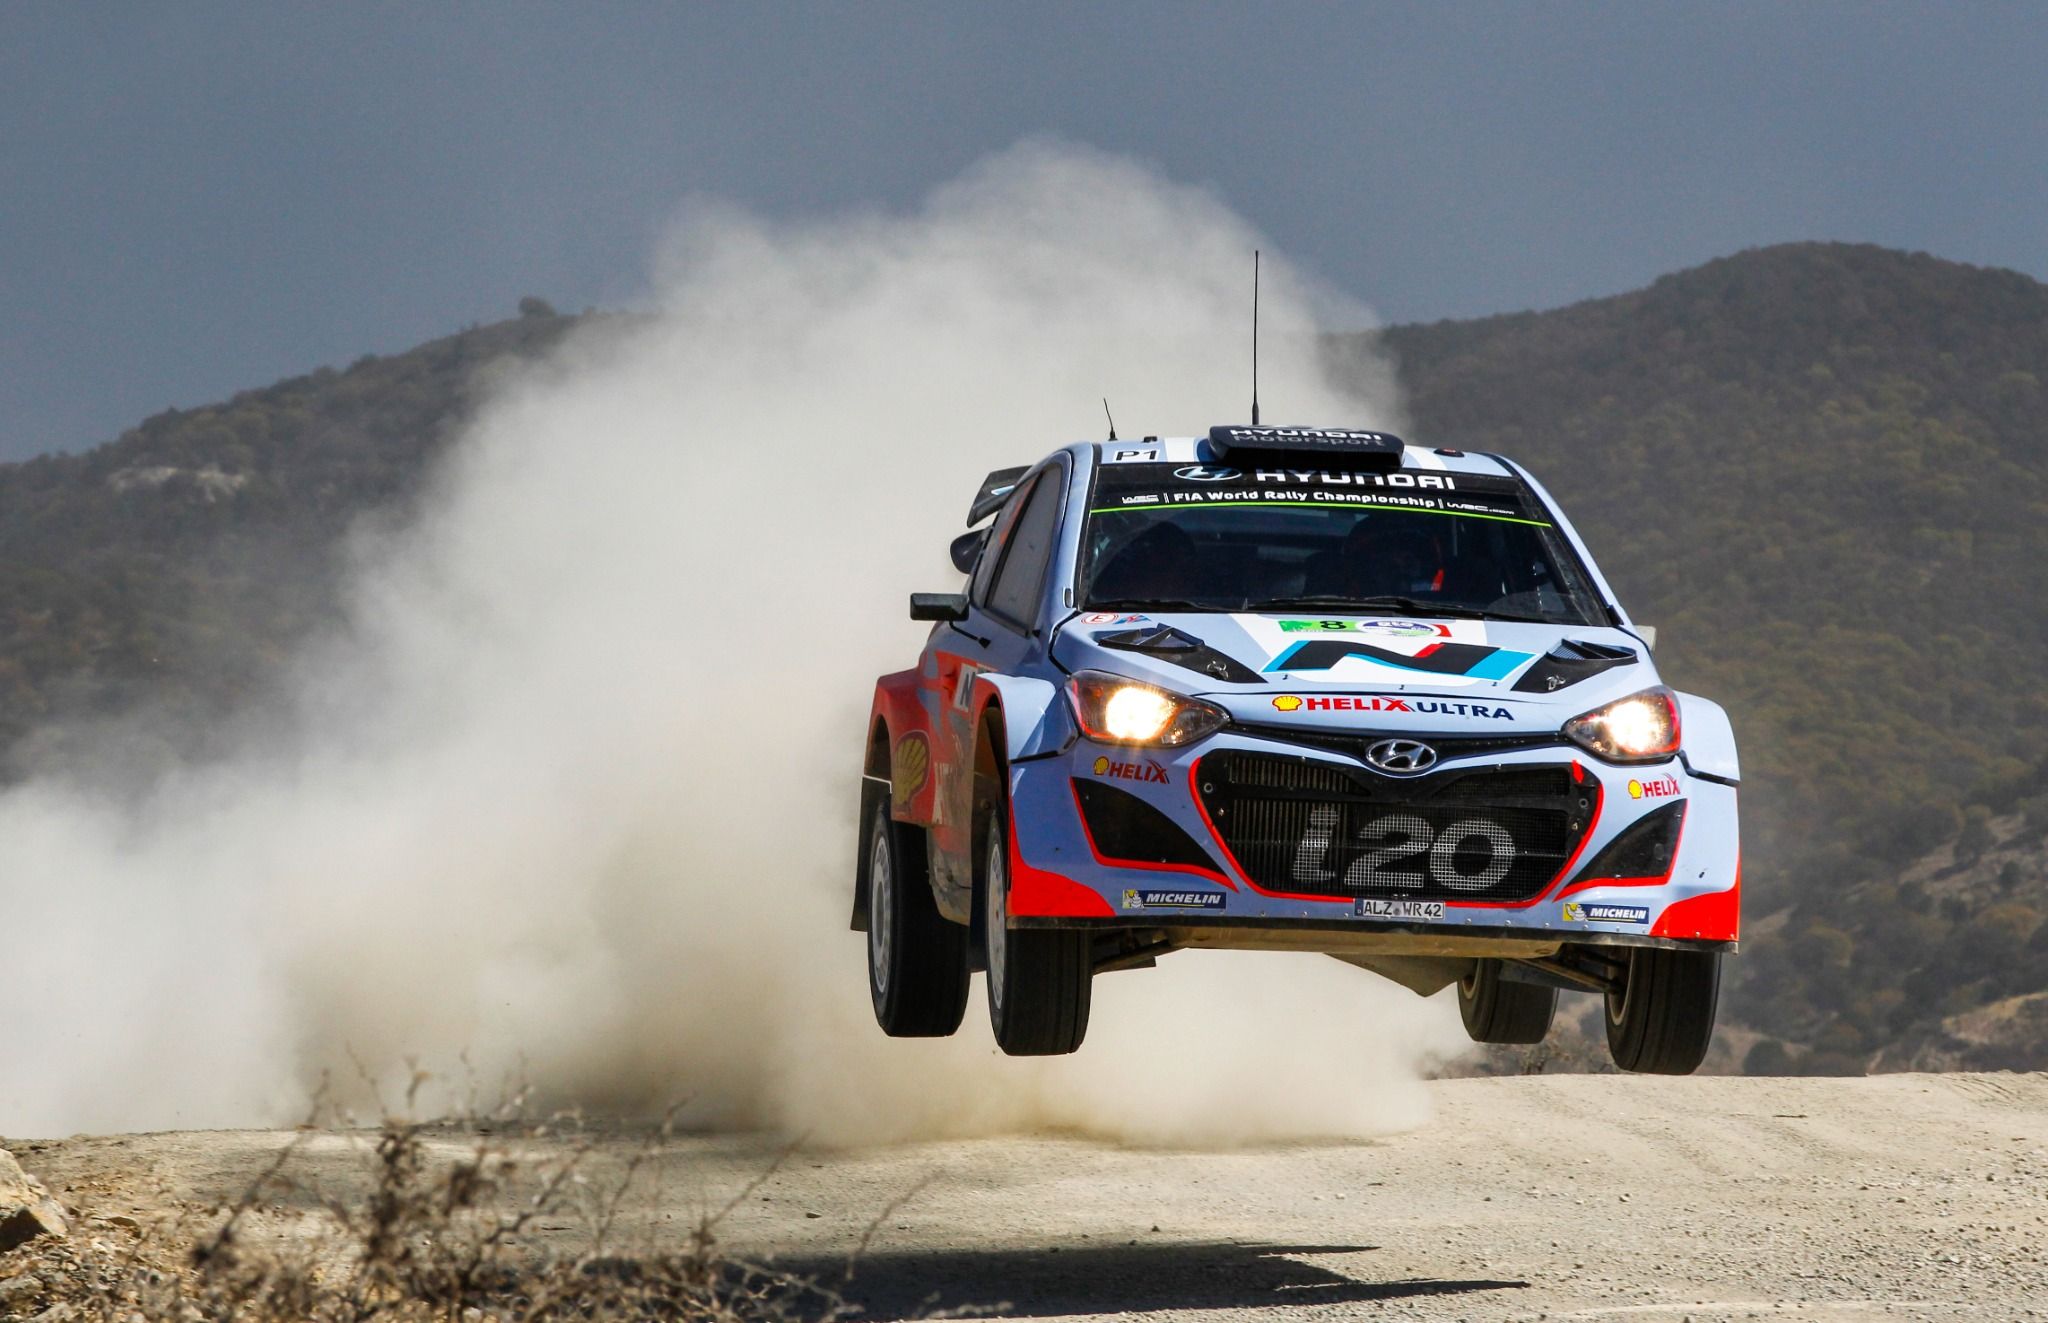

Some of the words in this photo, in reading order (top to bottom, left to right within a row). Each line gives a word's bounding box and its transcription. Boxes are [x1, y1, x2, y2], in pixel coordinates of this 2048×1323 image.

[1229, 429, 1383, 441] HYUNDAI
[1233, 434, 1386, 447] Motorsport
[1115, 450, 1157, 461] P1
[1255, 468, 1456, 490] HYUNDAI
[1173, 492, 1204, 502] FIA
[1206, 490, 1259, 500] World
[1264, 490, 1308, 501] Rally
[1313, 491, 1436, 508] Championship
[1319, 620, 1347, 630] 8
[1307, 695, 1413, 712] HELIX
[1416, 701, 1515, 721] ULTRA
[1108, 759, 1169, 784] HELIX
[1642, 773, 1681, 798] HELIX
[1146, 893, 1221, 904] MICHELIN
[1363, 901, 1393, 915] ALZ
[1590, 907, 1647, 919] MICHELIN
